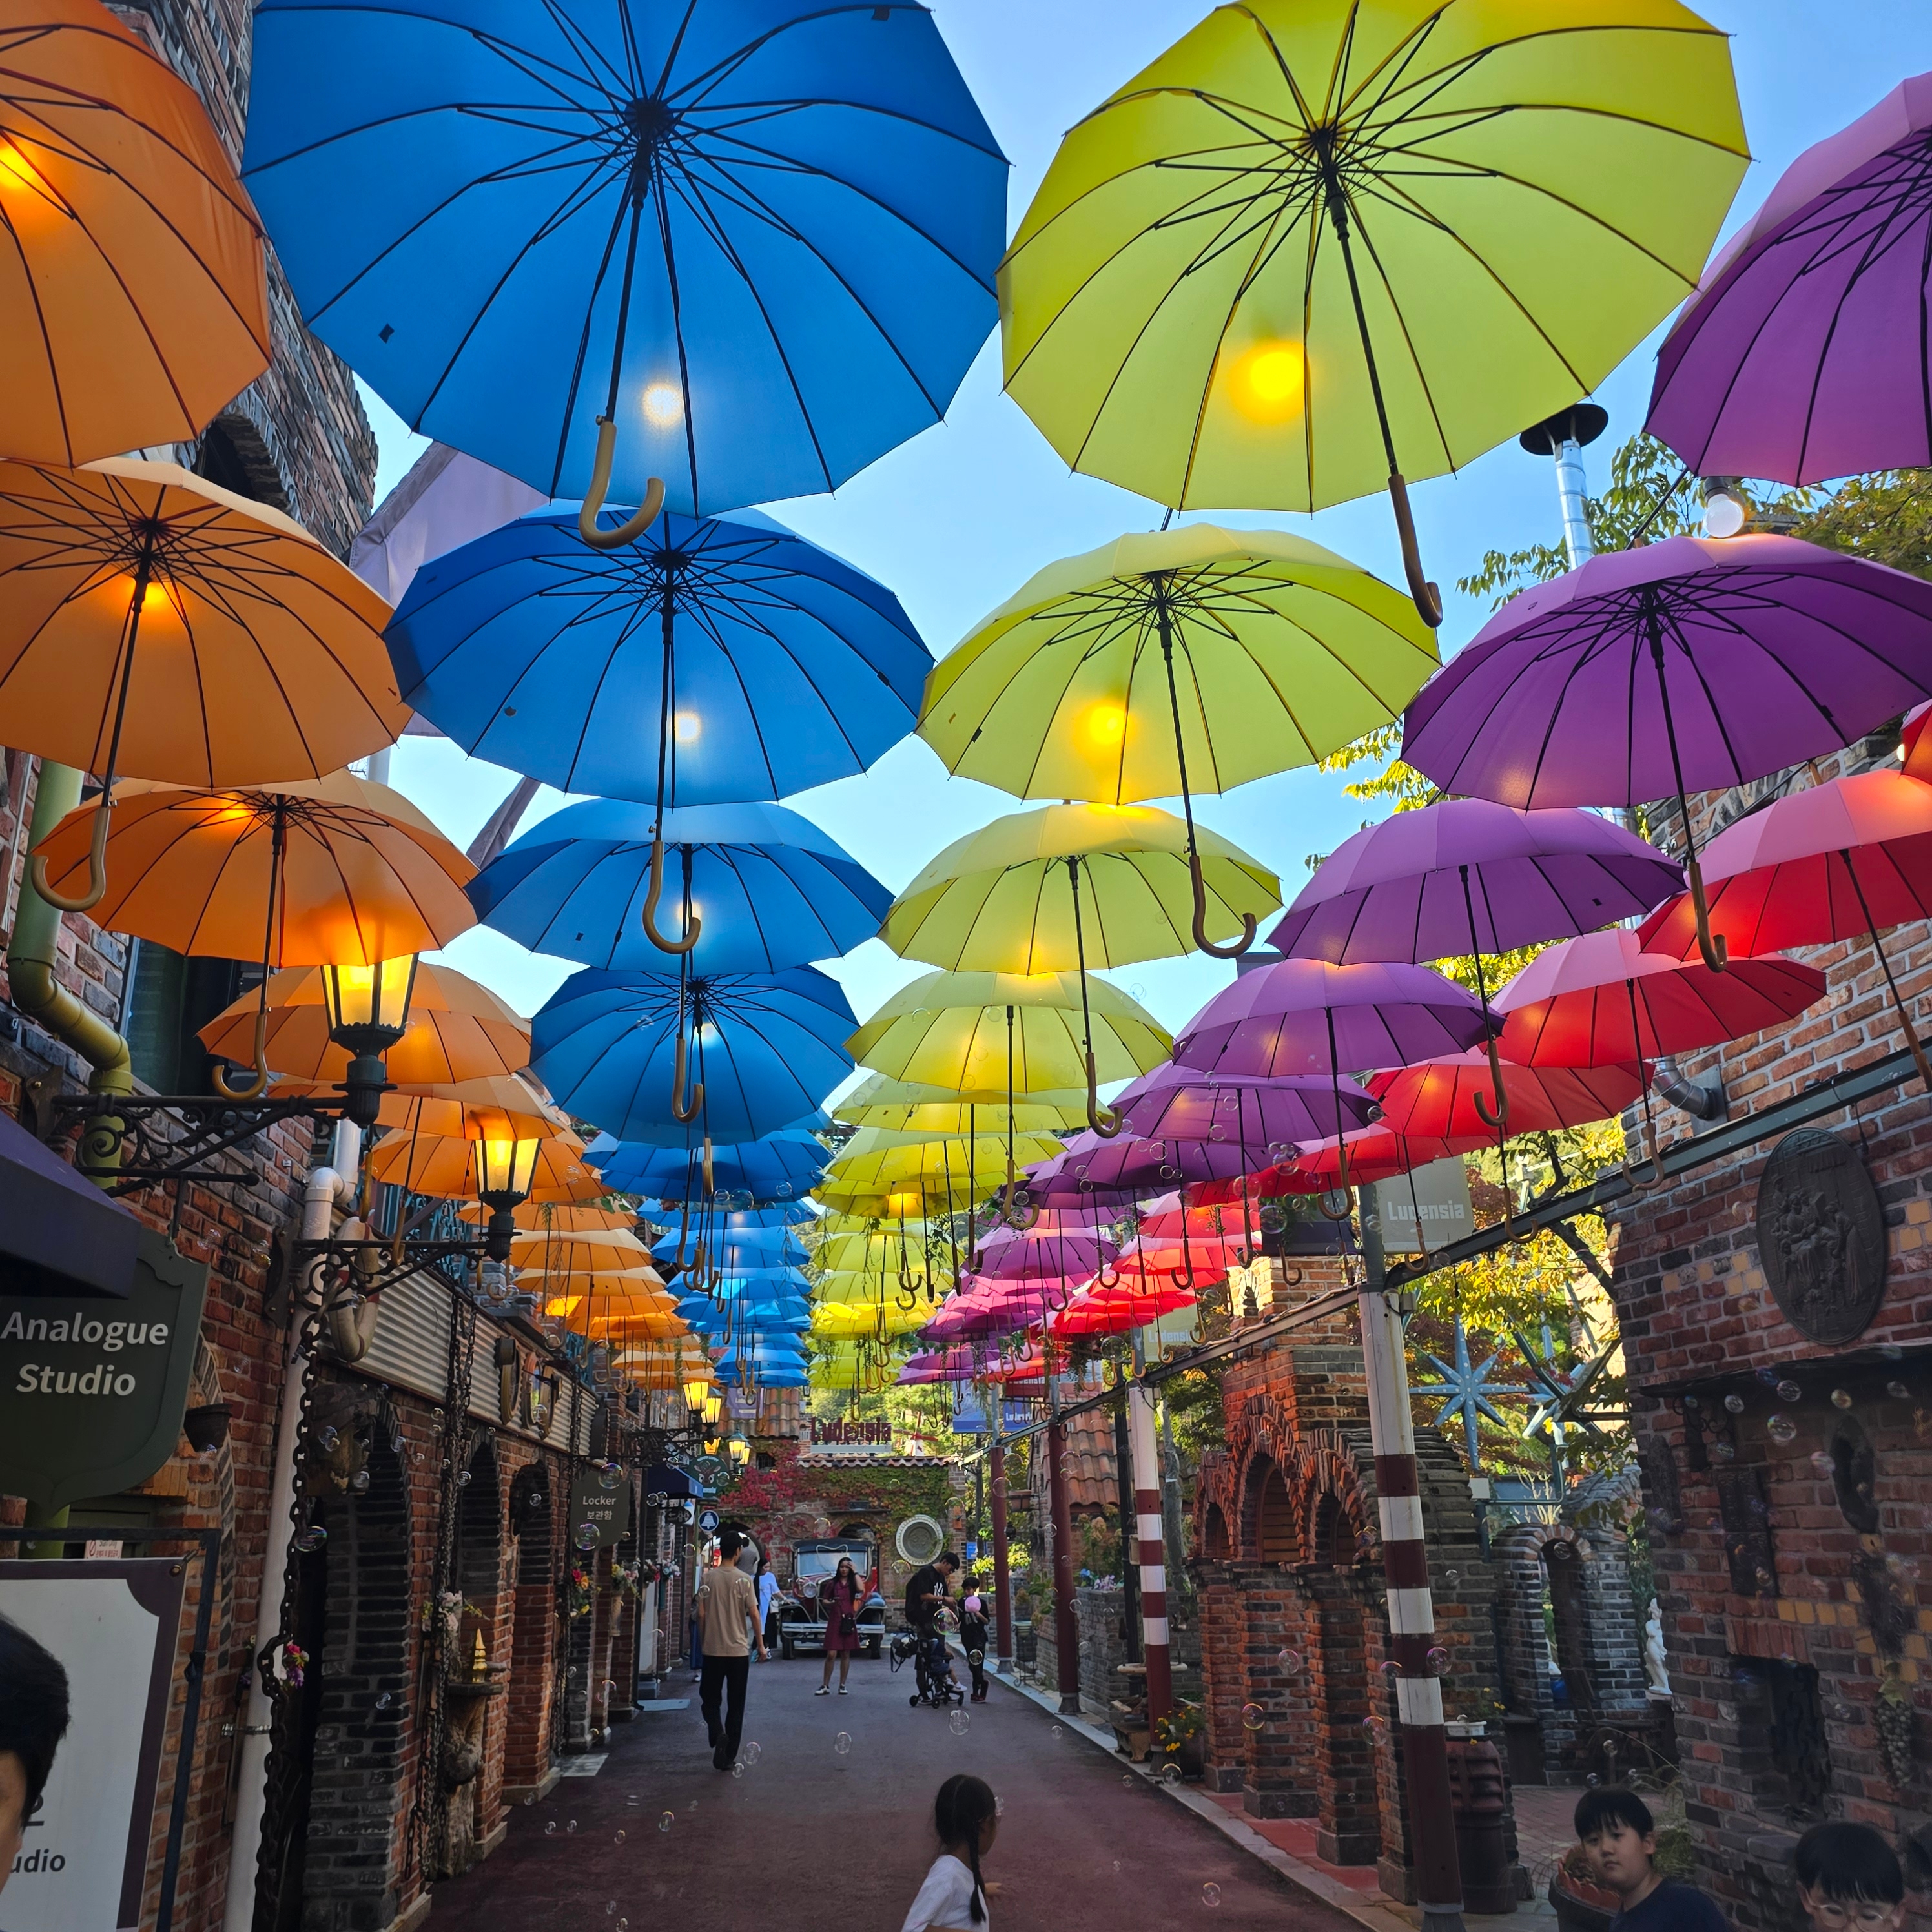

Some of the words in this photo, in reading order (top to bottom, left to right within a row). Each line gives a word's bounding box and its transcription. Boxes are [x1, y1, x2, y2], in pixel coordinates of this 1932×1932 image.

[0, 1311, 169, 1352] Analogue
[15, 1363, 136, 1396] Studio
[811, 1417, 892, 1442] Ludensia
[582, 1495, 617, 1505] Locker
[586, 1510, 613, 1521] 보관함
